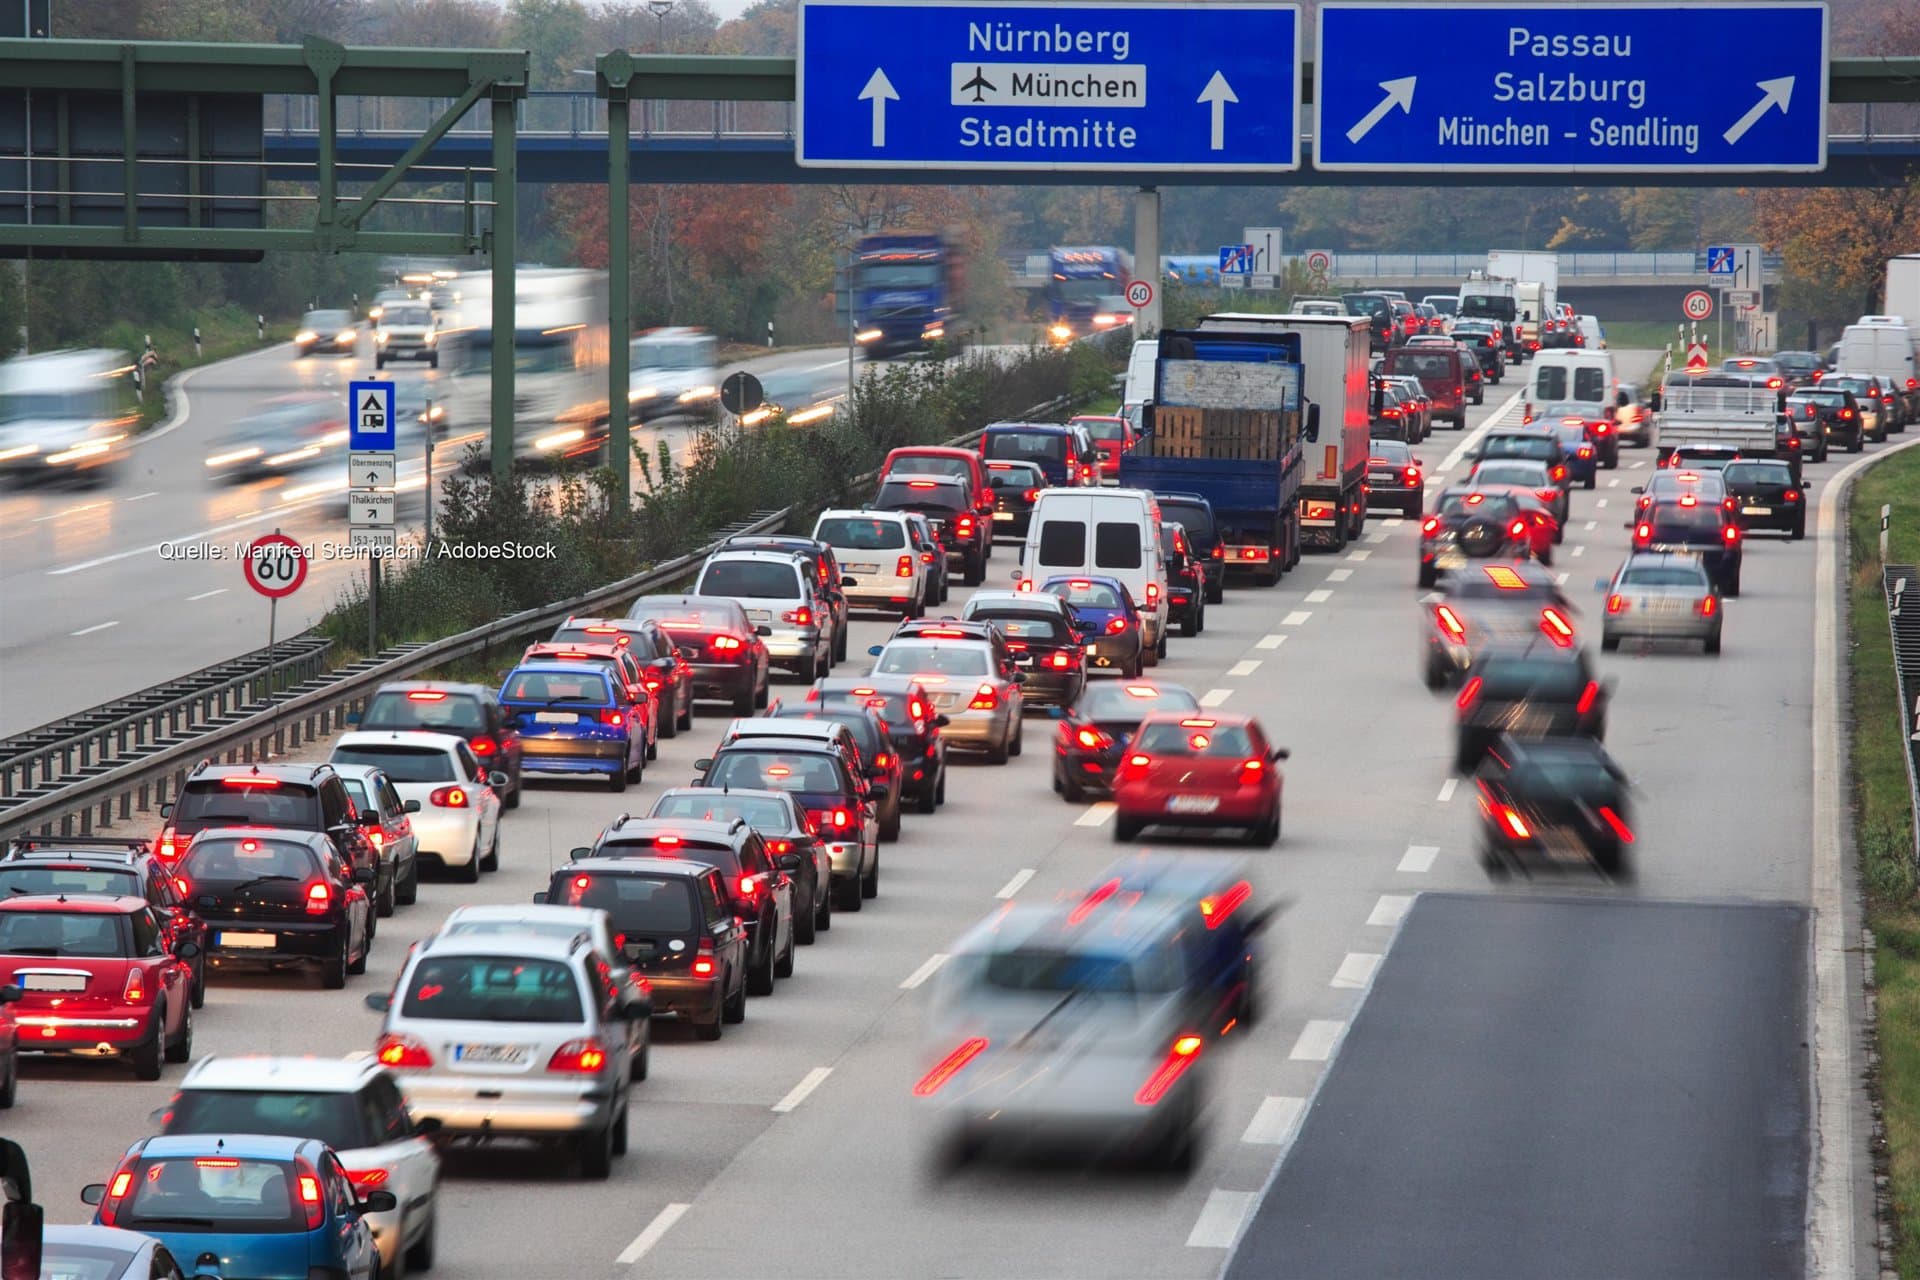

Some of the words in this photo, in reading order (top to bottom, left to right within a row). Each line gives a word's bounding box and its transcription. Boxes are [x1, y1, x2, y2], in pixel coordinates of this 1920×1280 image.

[968, 22, 1130, 60] Nürnberg
[1509, 27, 1632, 57] Passau
[1012, 73, 1137, 98] München
[1493, 72, 1646, 109] Salzburg
[959, 117, 1137, 149] Stadtmitte
[1438, 117, 1549, 147] München
[1589, 118, 1699, 153] Sendling
[1131, 288, 1147, 300] 60
[1690, 299, 1706, 312] 60
[352, 459, 392, 468] Obermenzing
[352, 495, 393, 505] Thalkirchen
[257, 550, 294, 581] 60
